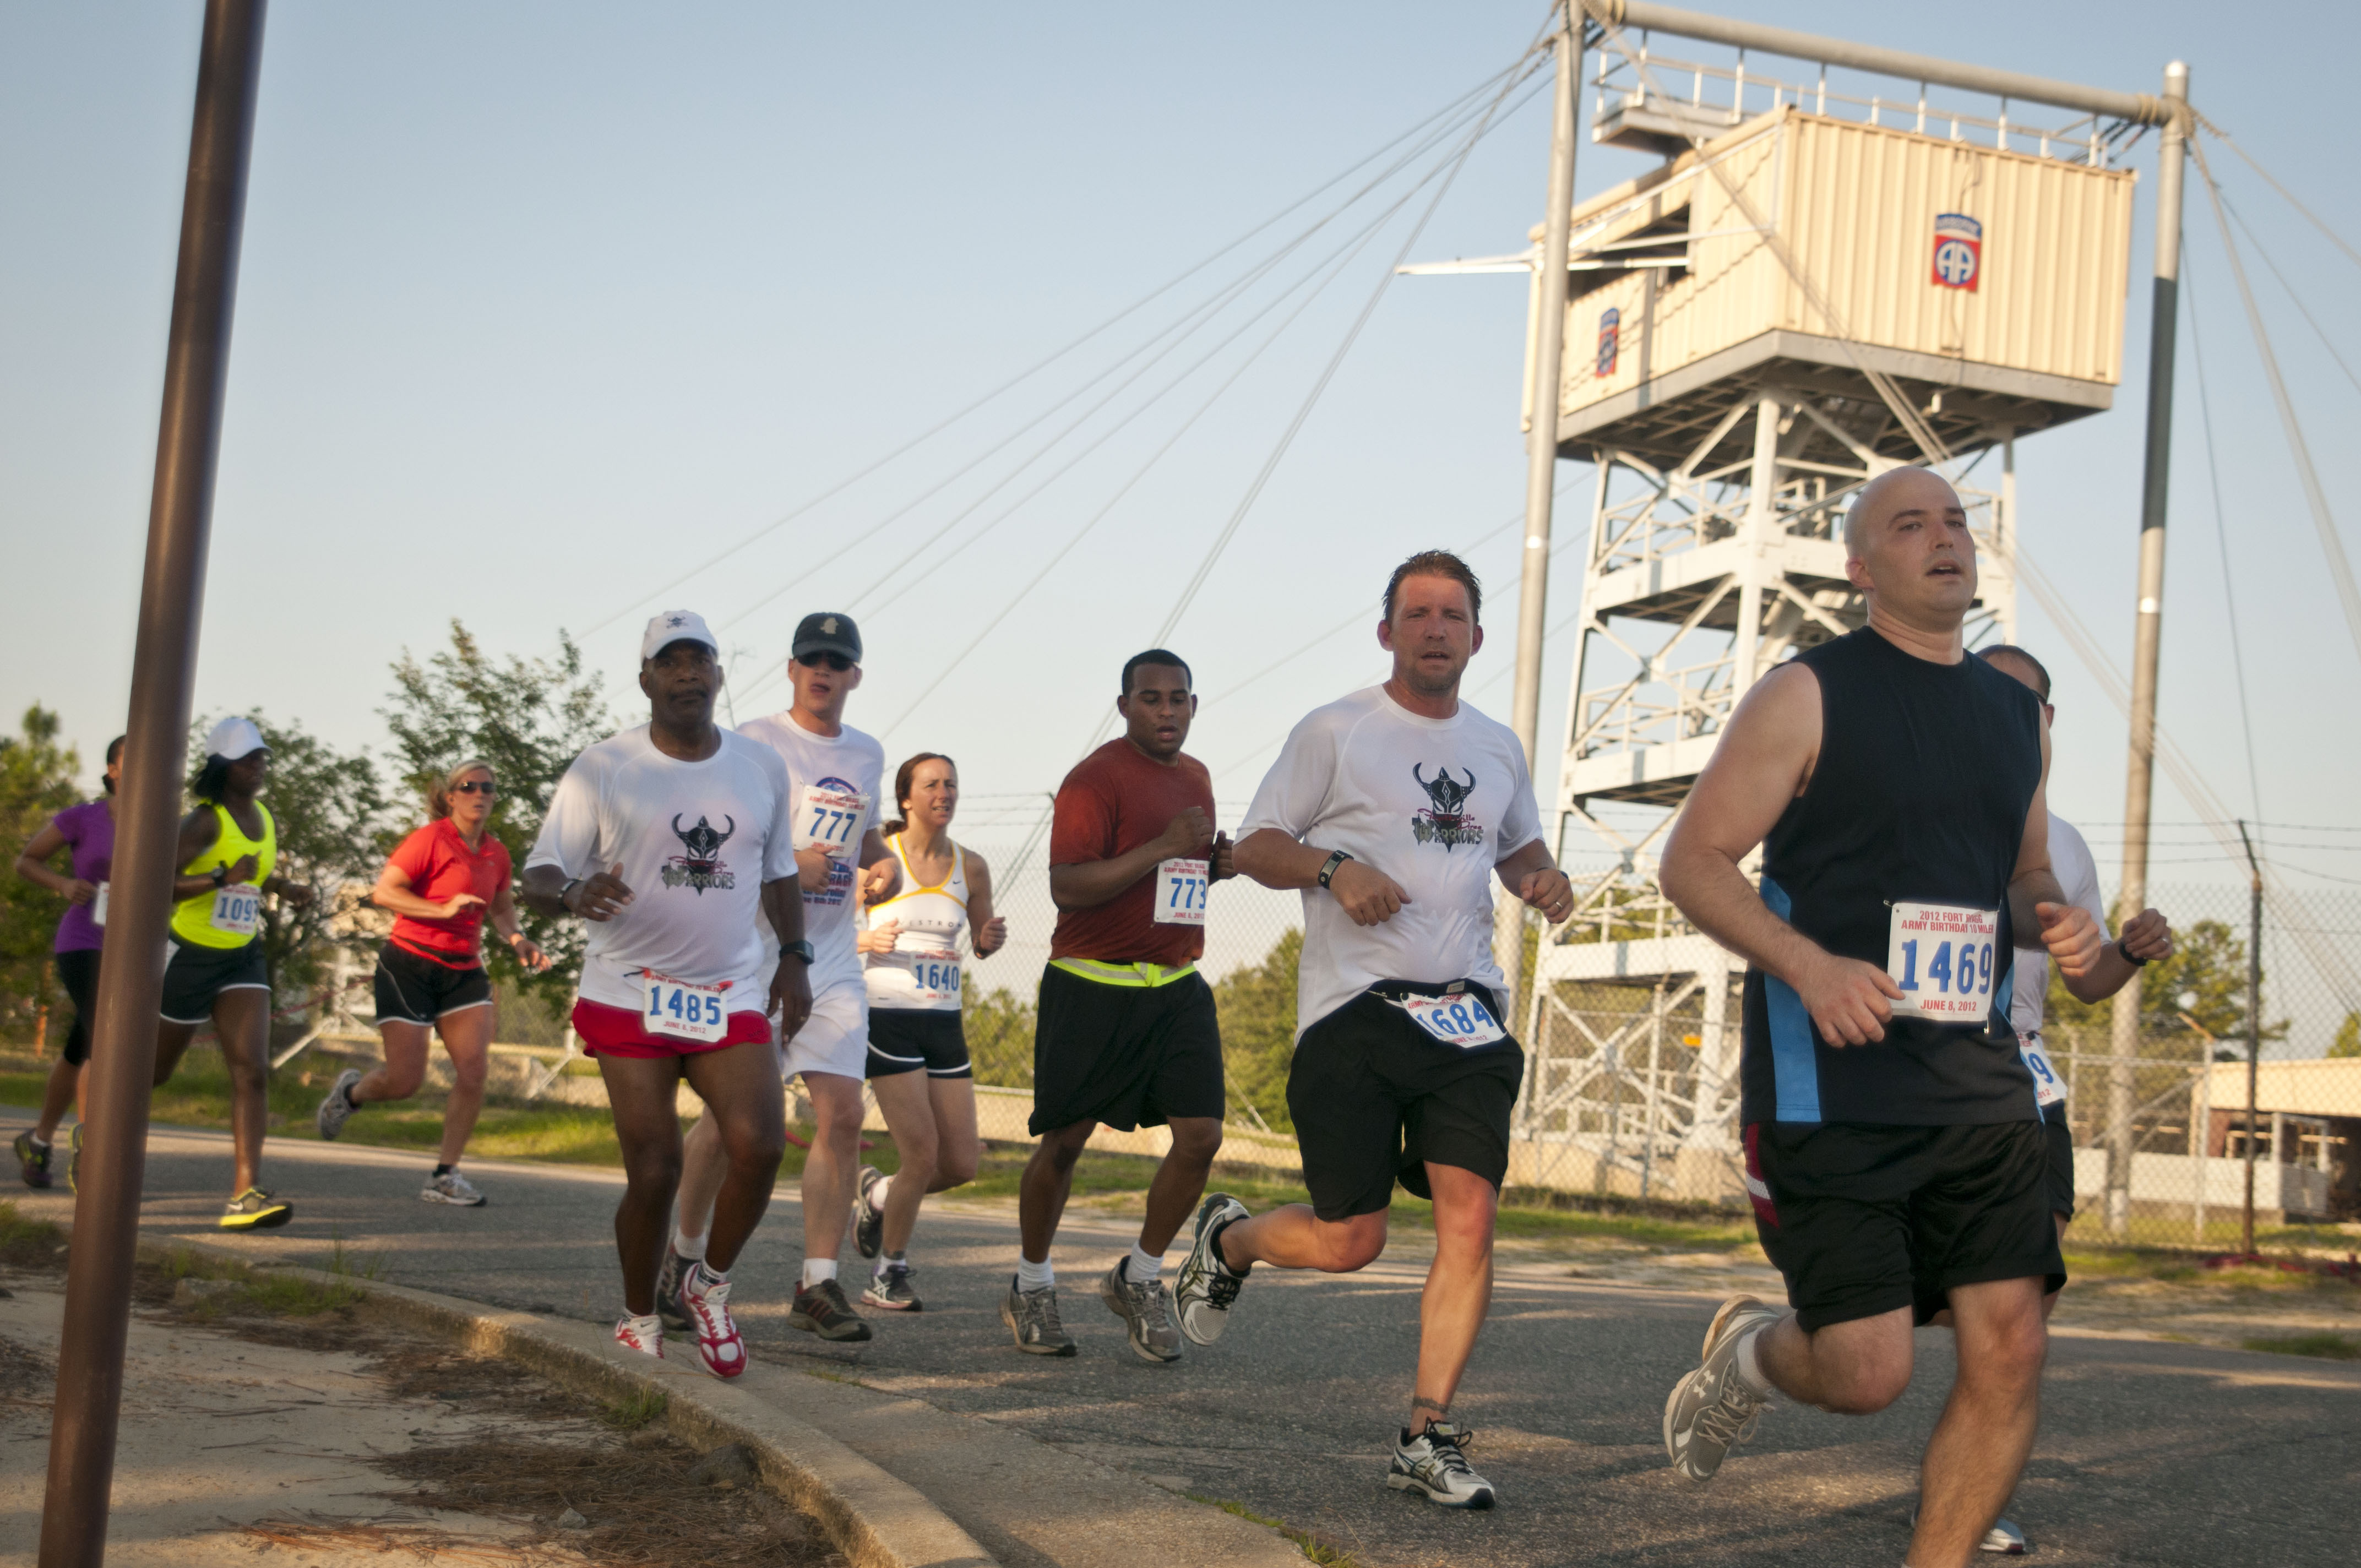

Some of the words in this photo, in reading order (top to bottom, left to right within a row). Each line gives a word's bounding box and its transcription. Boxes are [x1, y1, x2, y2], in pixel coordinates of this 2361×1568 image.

[809, 807, 857, 842] 777
[1170, 878, 1206, 909] 773
[1901, 920, 1927, 931] ARMY
[1930, 922, 1968, 934] BIRTHDAY
[1970, 924, 1977, 934] 10
[1919, 911, 1940, 921] 2012
[1943, 912, 1963, 922] FORT
[915, 963, 959, 992] 1640
[1898, 939, 1993, 995] 1469
[650, 986, 721, 1026] 1485
[1417, 1000, 1494, 1036] 1684
[1921, 999, 1946, 1011] JUNE
[1948, 1000, 1955, 1013] 8,
[1958, 1001, 1977, 1011] 2012
[2028, 1053, 2054, 1084] 9
